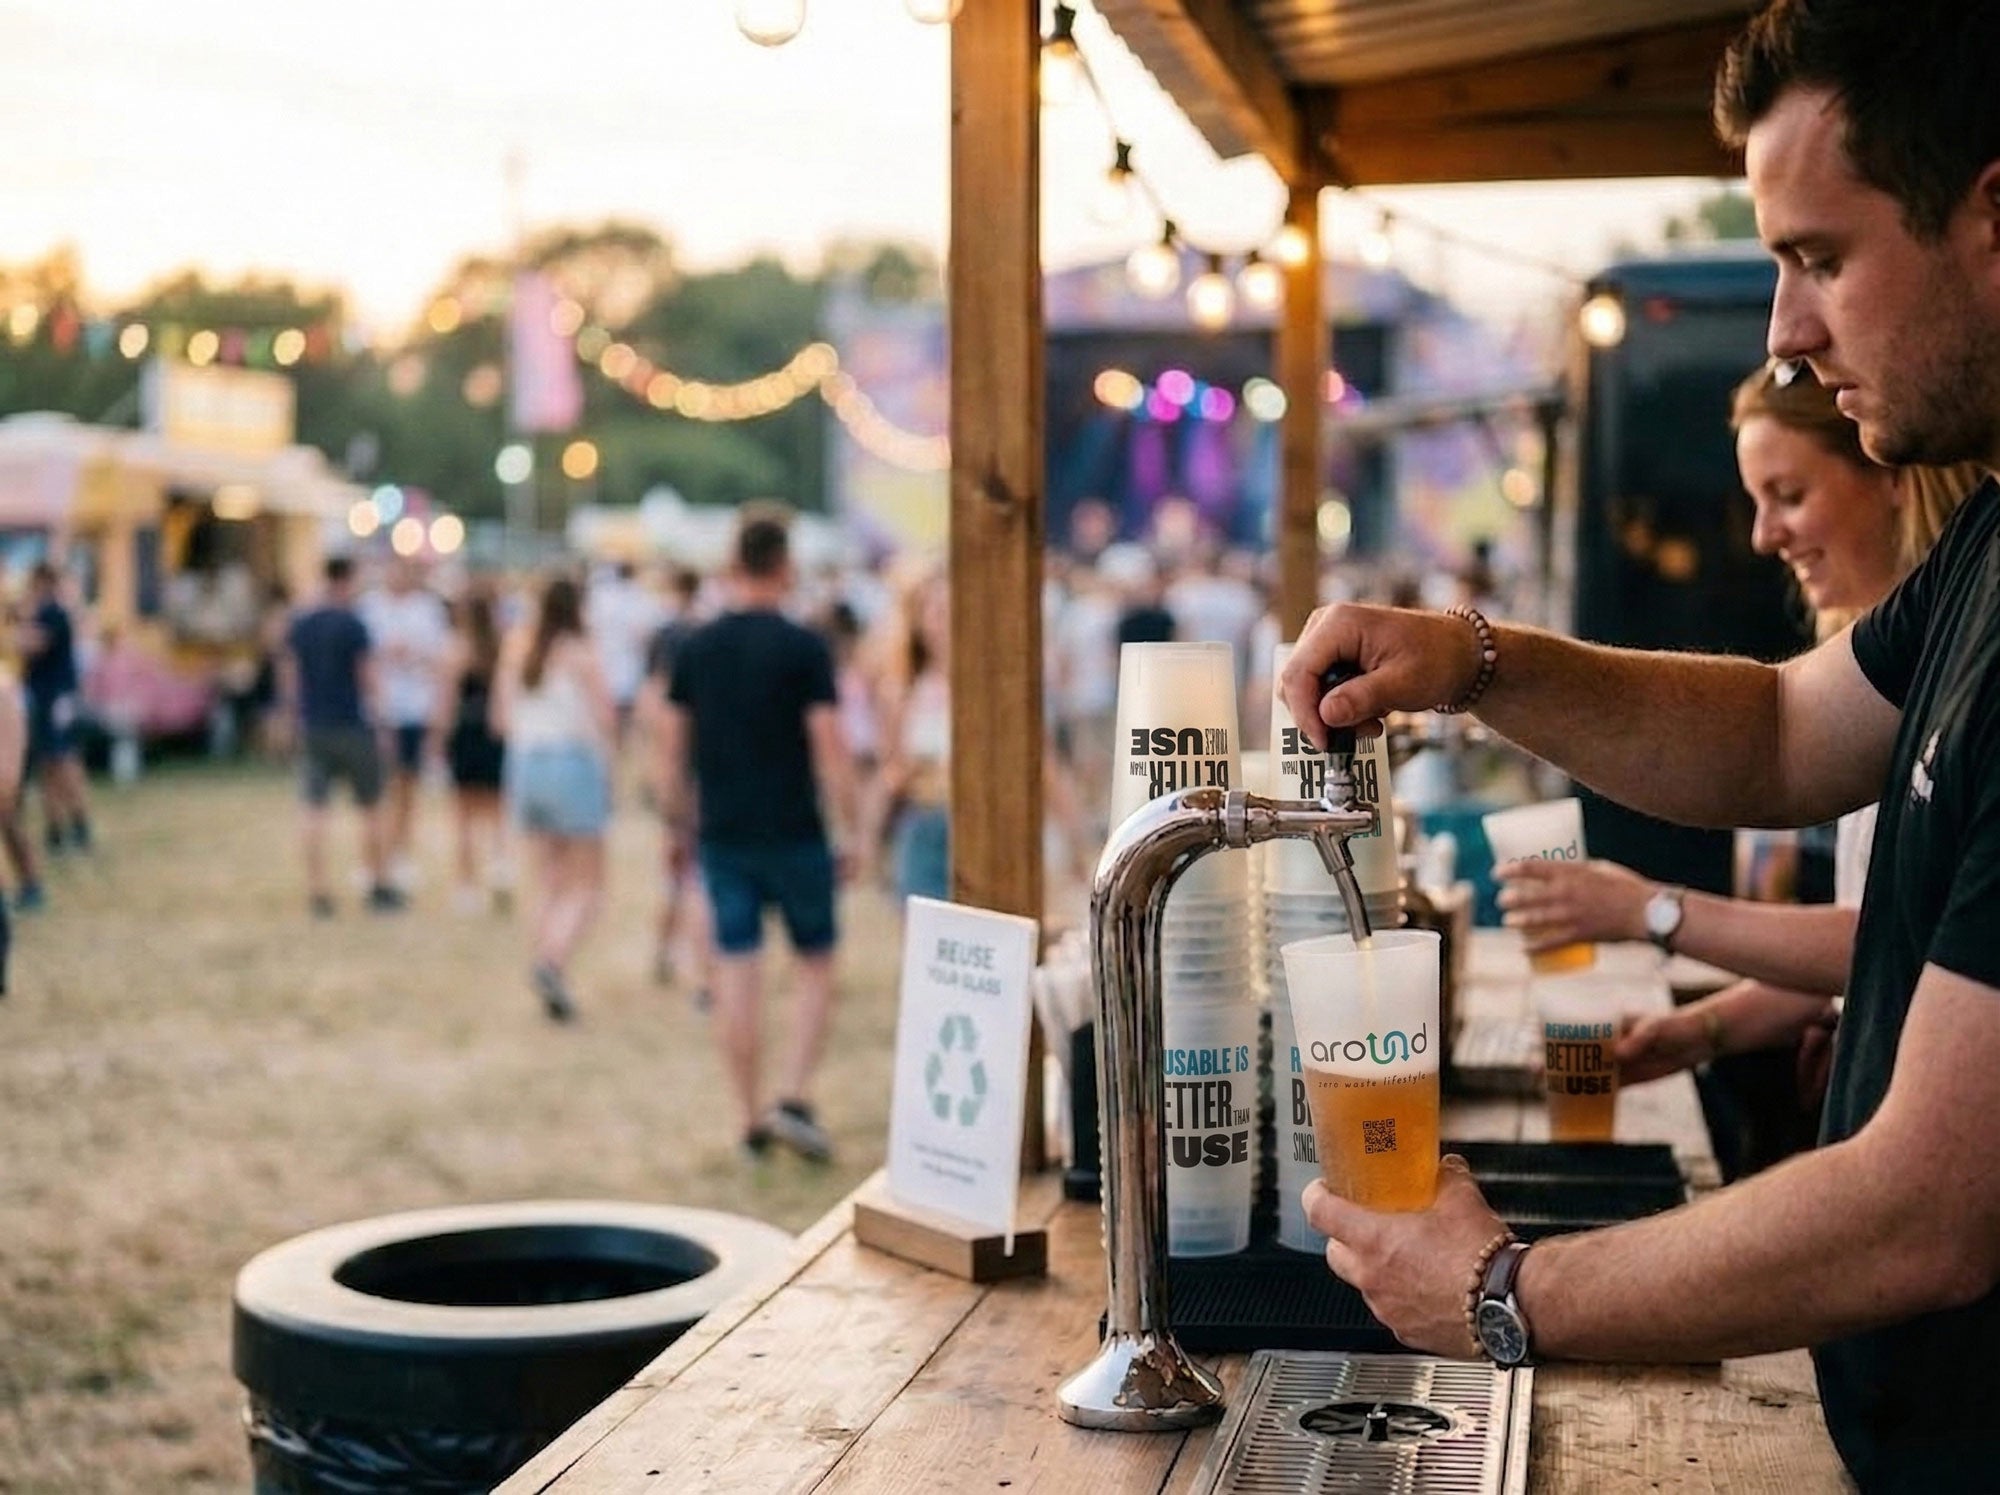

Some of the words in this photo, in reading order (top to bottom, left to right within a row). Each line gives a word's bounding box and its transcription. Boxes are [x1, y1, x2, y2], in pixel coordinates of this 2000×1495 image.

[1131, 727, 1203, 756] USE
[1130, 761, 1147, 776] THAN
[1299, 759, 1379, 803] BEER
[937, 938, 996, 970] REUSE
[1310, 1022, 1427, 1064] around
[1545, 1022, 1600, 1040] REUSABLE
[1163, 1047, 1231, 1075] USABLE
[1546, 1042, 1602, 1072] BETTER
[1345, 1078, 1377, 1088] waste
[1383, 1070, 1426, 1086] lifestyle
[1566, 1074, 1612, 1095] USE
[1164, 1080, 1232, 1129] ETTER
[1172, 1130, 1249, 1168] USE
[1293, 1131, 1319, 1163] SINGL
